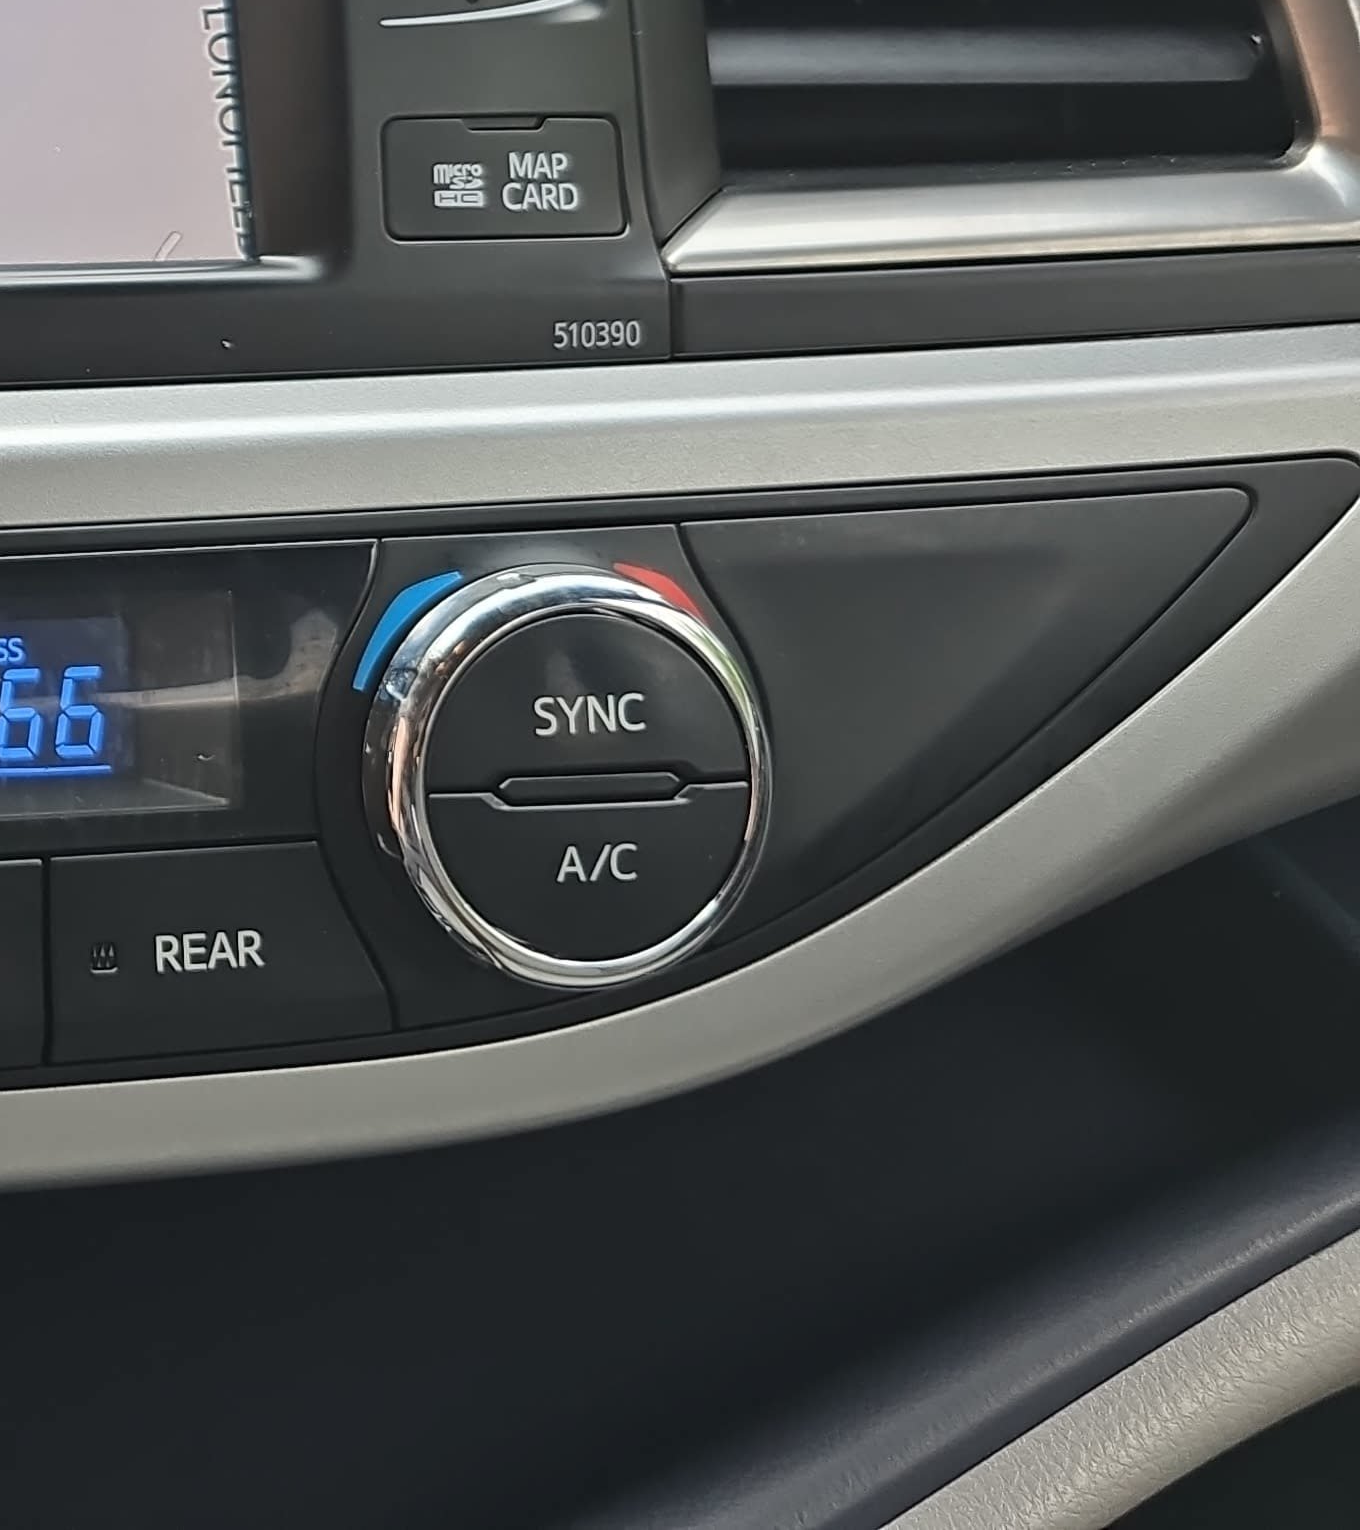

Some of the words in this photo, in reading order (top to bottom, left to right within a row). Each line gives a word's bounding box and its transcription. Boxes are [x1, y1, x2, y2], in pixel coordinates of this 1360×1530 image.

[508, 152, 569, 179] MAP
[502, 182, 579, 211] CARD
[553, 321, 640, 350] 510390
[534, 693, 646, 736] SYNC
[557, 843, 638, 884] A/C
[155, 930, 265, 971] REAR
